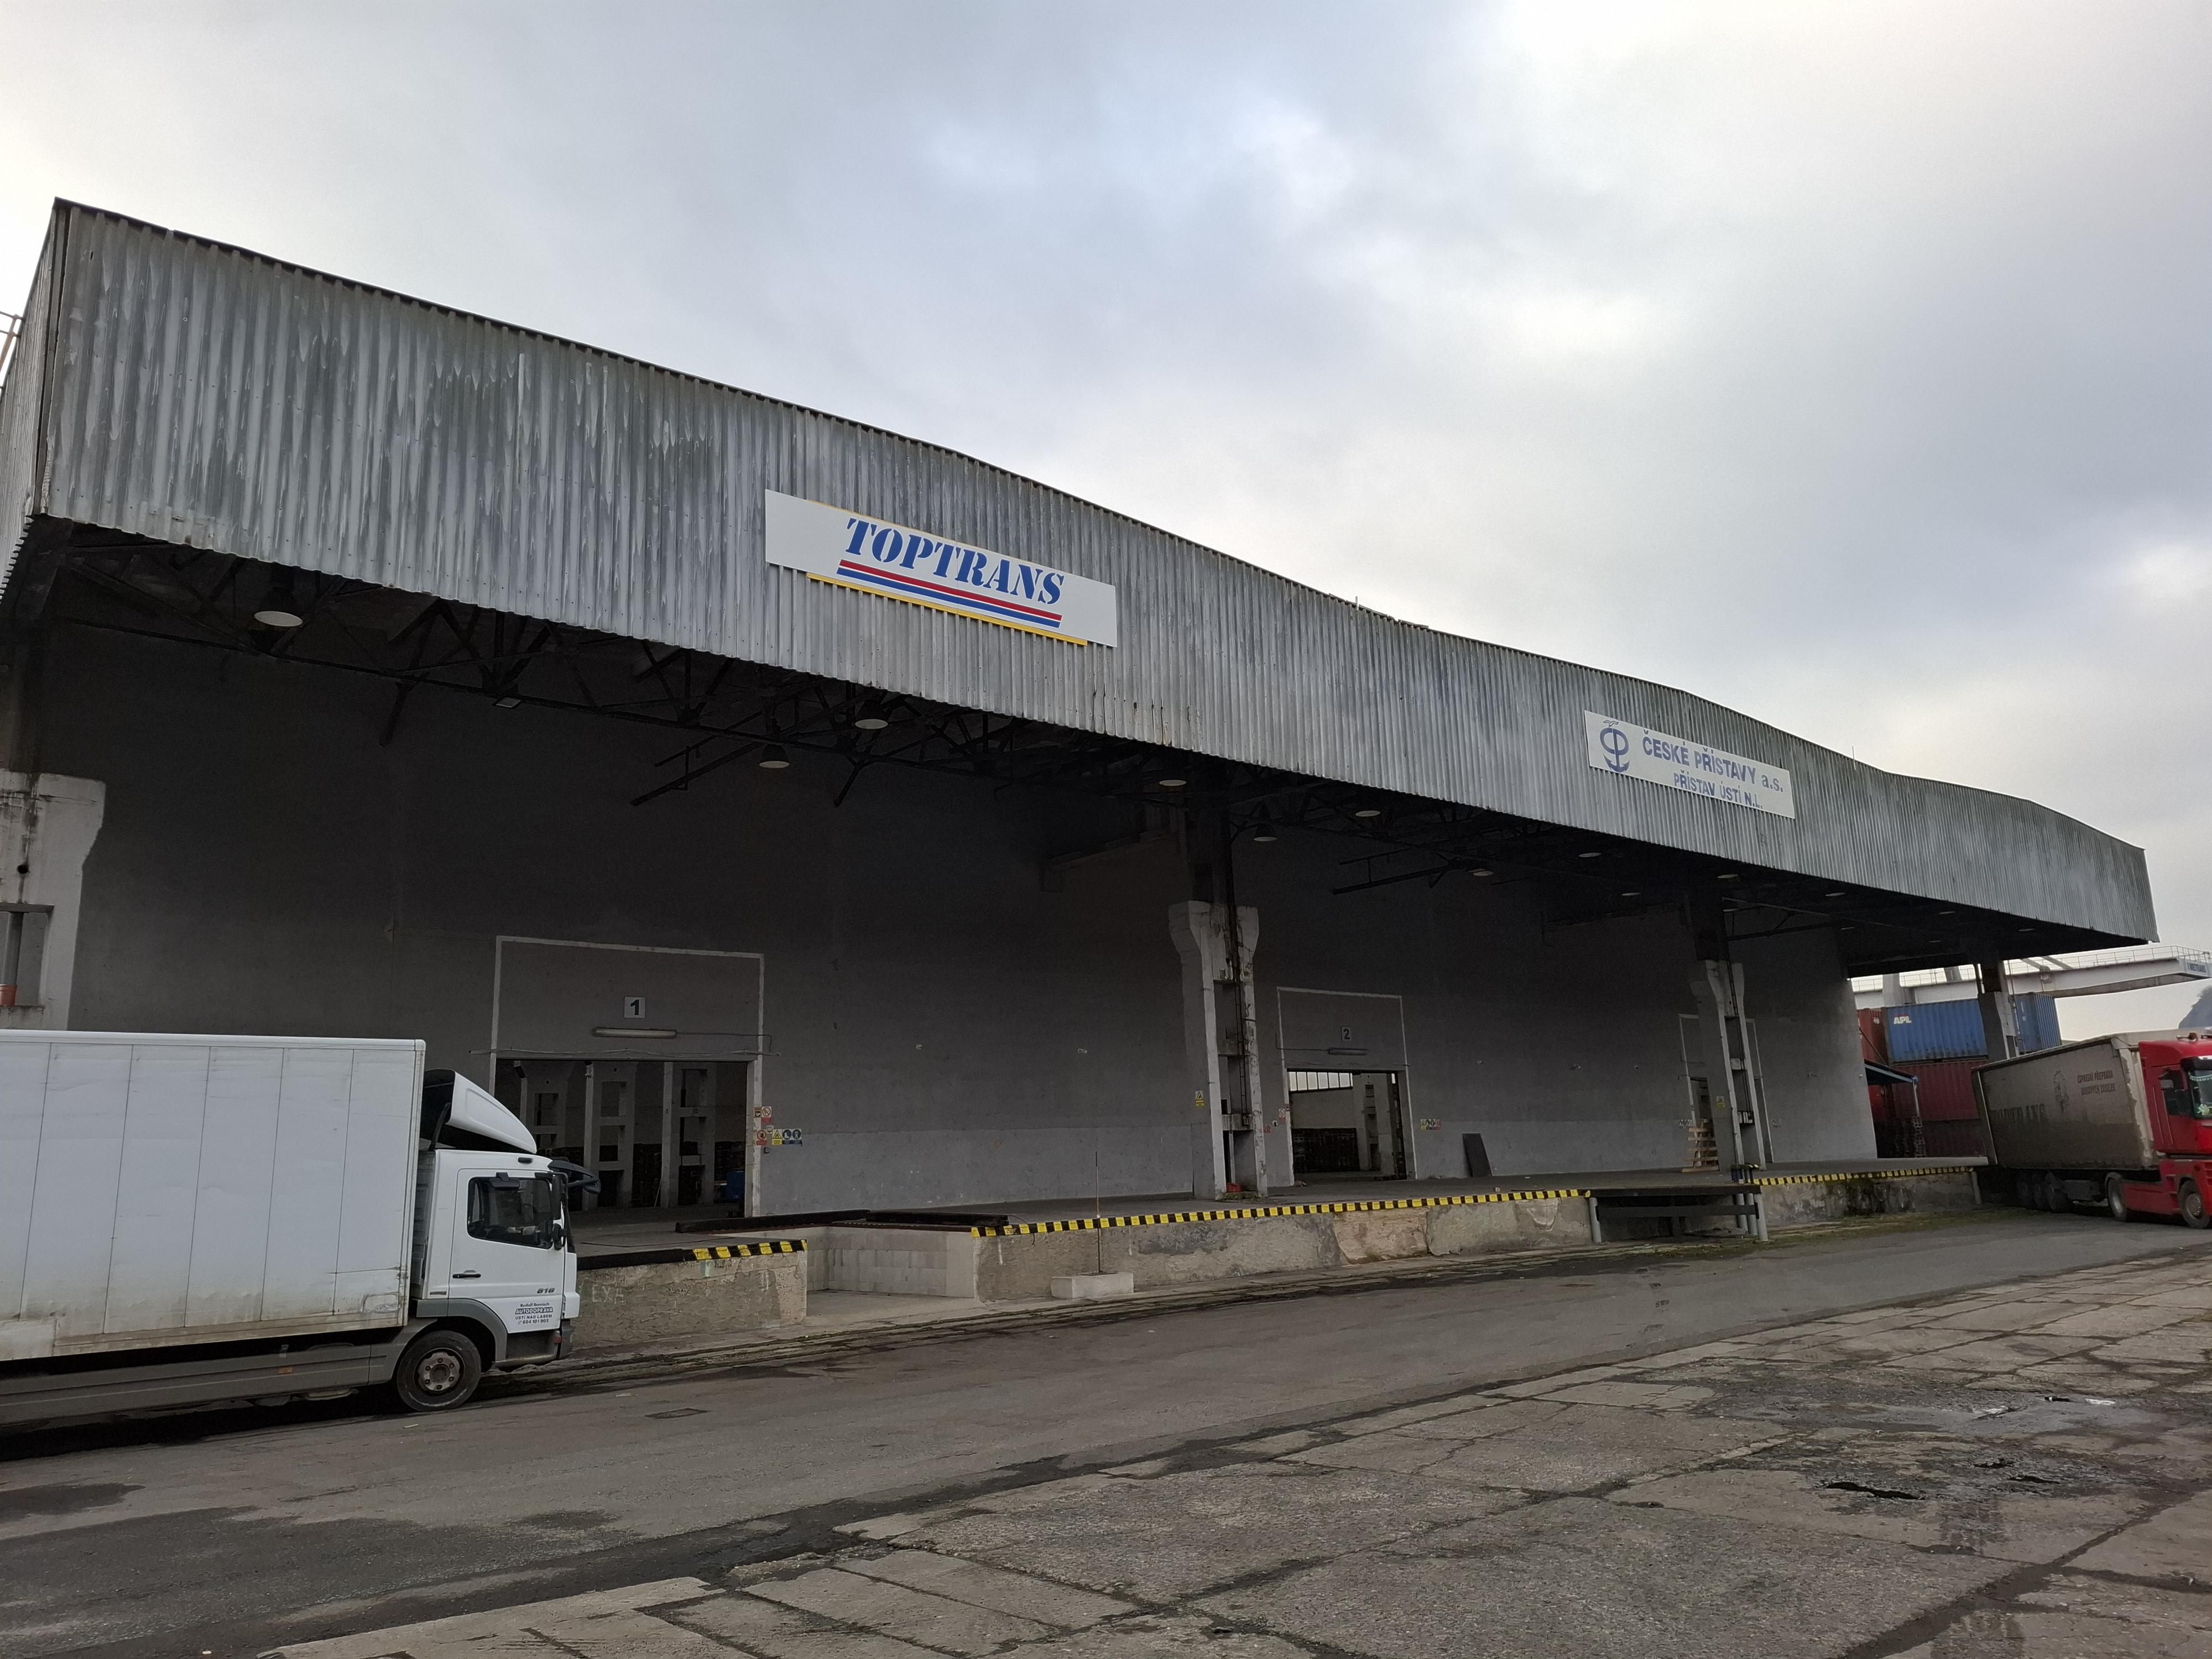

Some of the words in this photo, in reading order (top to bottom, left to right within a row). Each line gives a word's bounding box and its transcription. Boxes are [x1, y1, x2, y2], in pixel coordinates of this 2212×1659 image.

[845, 518, 1065, 604] TOPTRANS
[1642, 729, 1689, 766] ČESKÉ
[1694, 747, 1756, 784] PŘÍSTAVY
[1761, 774, 1783, 792] a.s.
[1673, 769, 1715, 796] PŘÍSTAV
[1719, 781, 1742, 803] ÚSTÍ
[1744, 791, 1763, 809] N.L.
[630, 999, 639, 1015] 1
[1893, 1016, 1912, 1024] APL
[1344, 1029, 1350, 1040] 2
